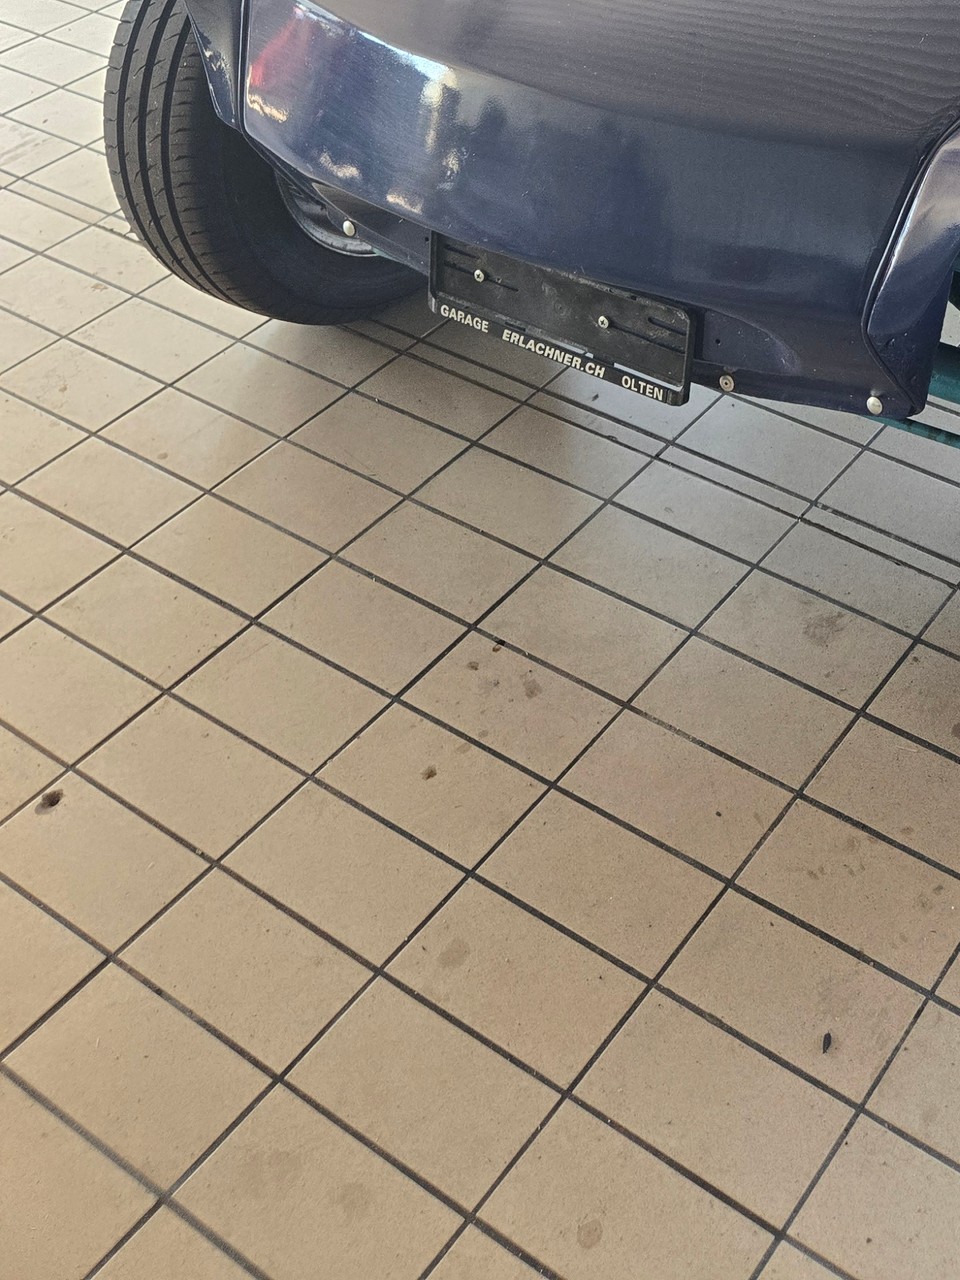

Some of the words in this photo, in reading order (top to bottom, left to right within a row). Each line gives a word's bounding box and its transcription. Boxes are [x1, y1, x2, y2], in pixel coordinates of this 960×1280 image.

[440, 304, 489, 333] GARAGE
[502, 329, 606, 379] ERLACHNER.CH
[621, 375, 663, 401] OLTEN
